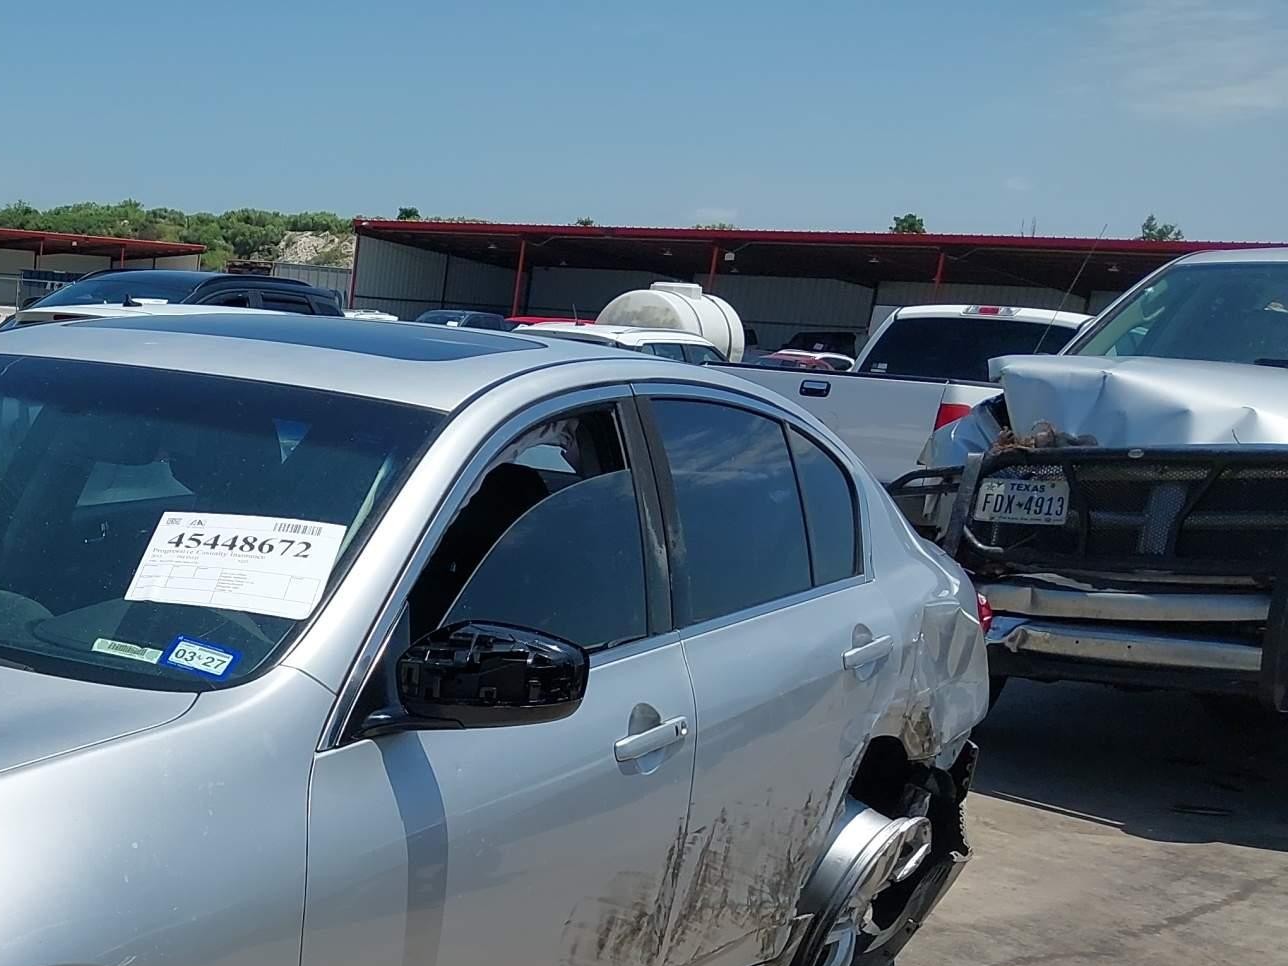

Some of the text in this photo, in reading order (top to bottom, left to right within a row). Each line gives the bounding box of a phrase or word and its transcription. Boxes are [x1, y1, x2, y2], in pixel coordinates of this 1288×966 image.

[1010, 483, 1046, 493] TEXAS
[153, 548, 195, 556] Progressive
[167, 532, 312, 559] 45448672
[175, 648, 197, 662] 03
[202, 656, 227, 670] 27
